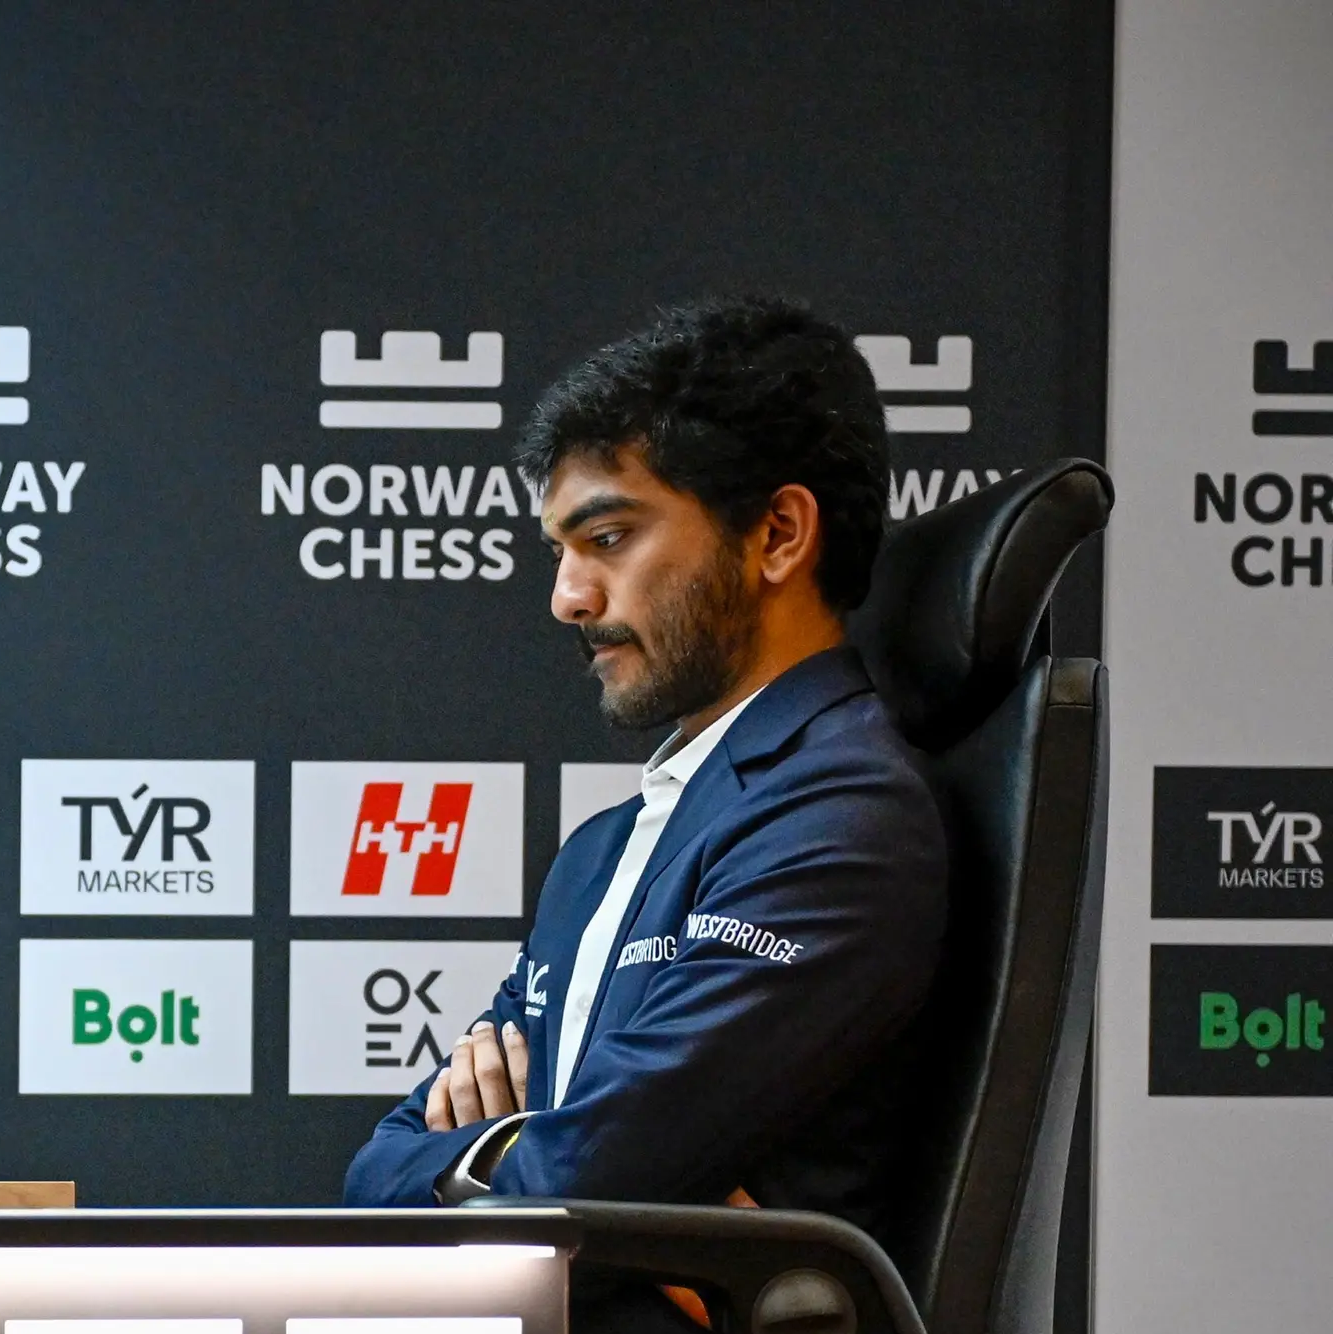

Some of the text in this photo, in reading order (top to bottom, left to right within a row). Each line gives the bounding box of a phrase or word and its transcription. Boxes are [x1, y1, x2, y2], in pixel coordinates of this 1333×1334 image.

[300, 527, 513, 580] CHESS
[1231, 535, 1333, 588] CH
[78, 870, 214, 893] MARKETS
[1219, 868, 1323, 888] MARKETS
[686, 914, 805, 964] WESTBRIDGE
[364, 969, 442, 1015] OK
[73, 989, 199, 1063] Bolt
[1200, 992, 1325, 1067] Bolt
